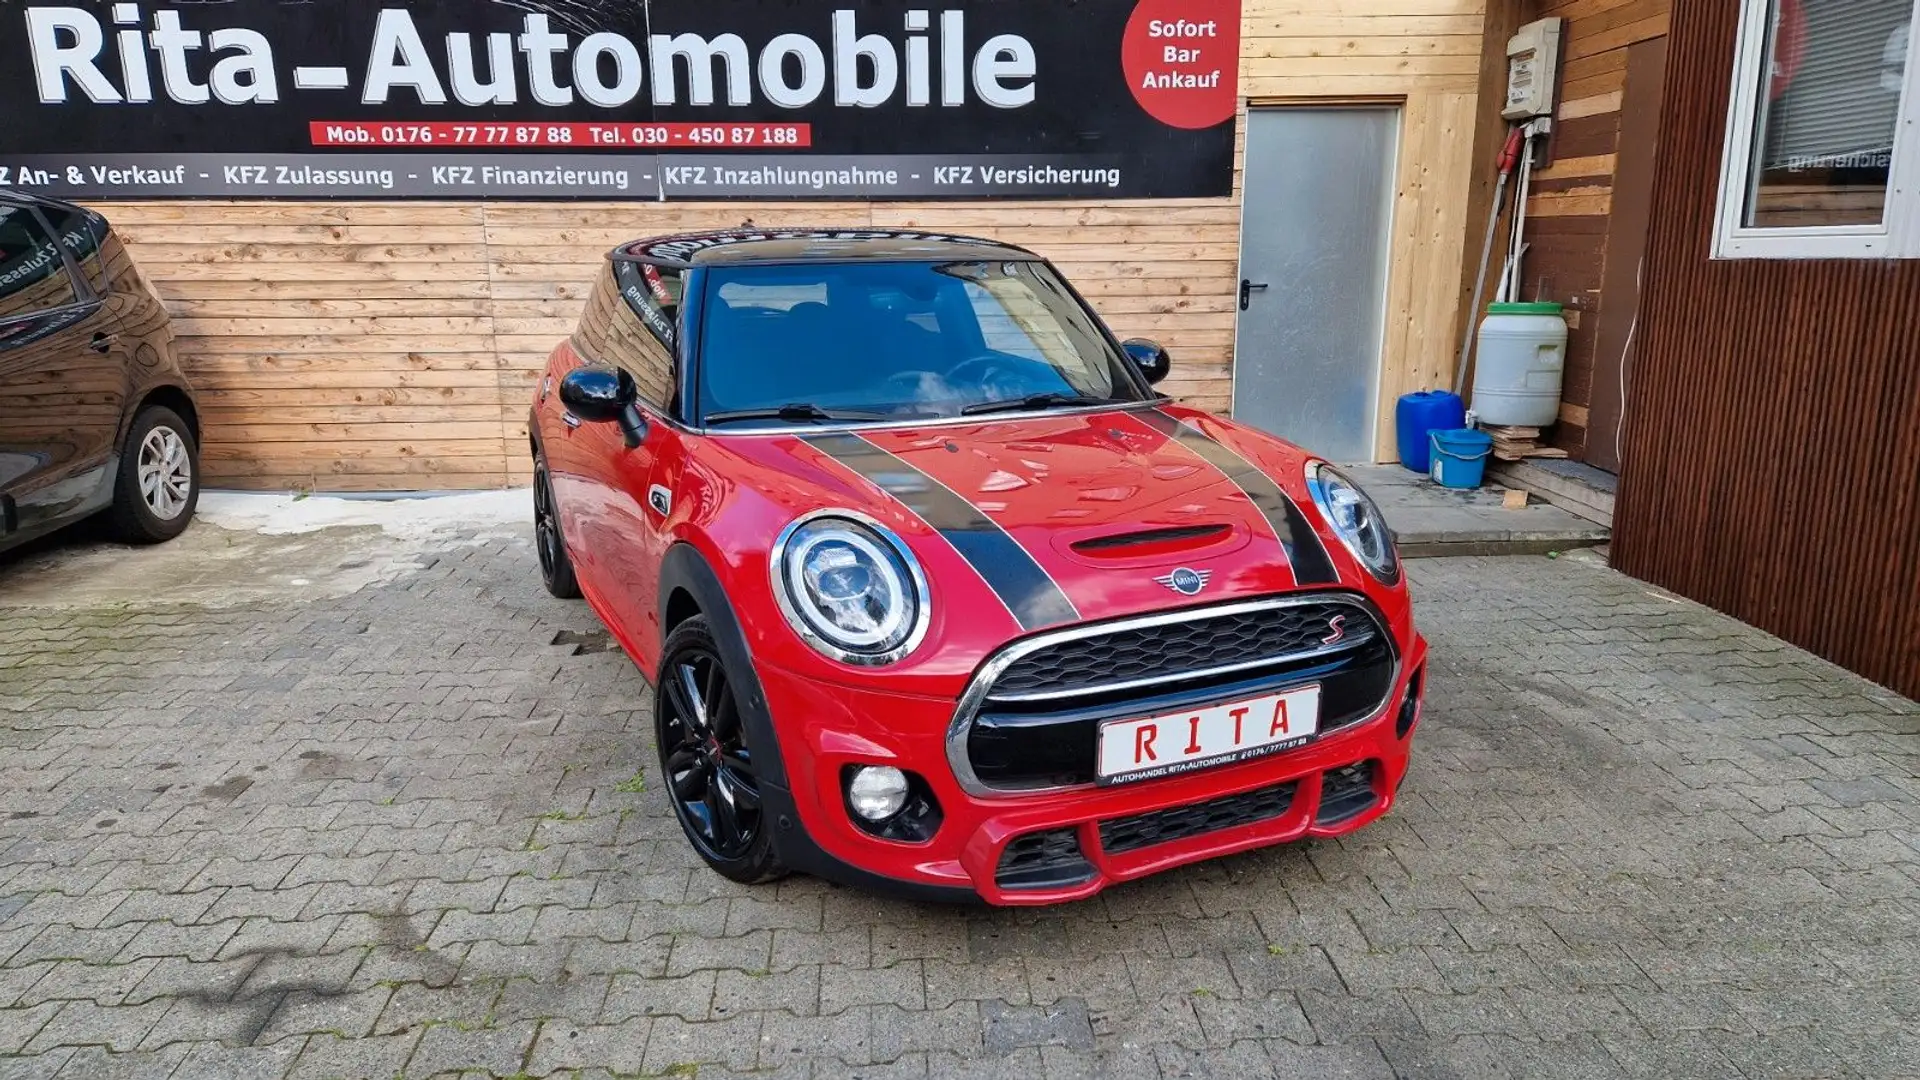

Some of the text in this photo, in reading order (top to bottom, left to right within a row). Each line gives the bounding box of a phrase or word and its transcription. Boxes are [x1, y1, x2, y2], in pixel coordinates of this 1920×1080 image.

[1148, 19, 1217, 38] Sofort
[1163, 46, 1201, 63] Bar
[1142, 69, 1221, 89] Ankauf
[327, 126, 376, 144] Mob.
[381, 126, 433, 144] 0176
[453, 127, 478, 144] 77
[484, 127, 509, 144] 77
[515, 127, 540, 144] 87
[547, 127, 573, 144] 88
[589, 127, 626, 144] Tel.
[632, 127, 668, 144] 030
[688, 127, 725, 144] 450
[731, 127, 755, 144] 87
[762, 127, 798, 144] 188
[18, 166, 59, 185] An-
[66, 166, 86, 185] &
[90, 165, 185, 185] Verkauf
[223, 166, 269, 184] KFZ
[274, 165, 394, 189] Zulassung
[431, 166, 476, 185] KFZ
[481, 165, 629, 190] Finanzierung
[665, 166, 707, 185] KFZ
[712, 165, 898, 189] Inzahlungnahme
[933, 166, 974, 184] KFZ
[979, 165, 1120, 188] Versicherung
[1175, 576, 1198, 586] MINI
[1321, 614, 1345, 645] S
[1111, 768, 1168, 784] AUTOHANDEL
[1168, 753, 1237, 773] RITA-AUTOMOBILE
